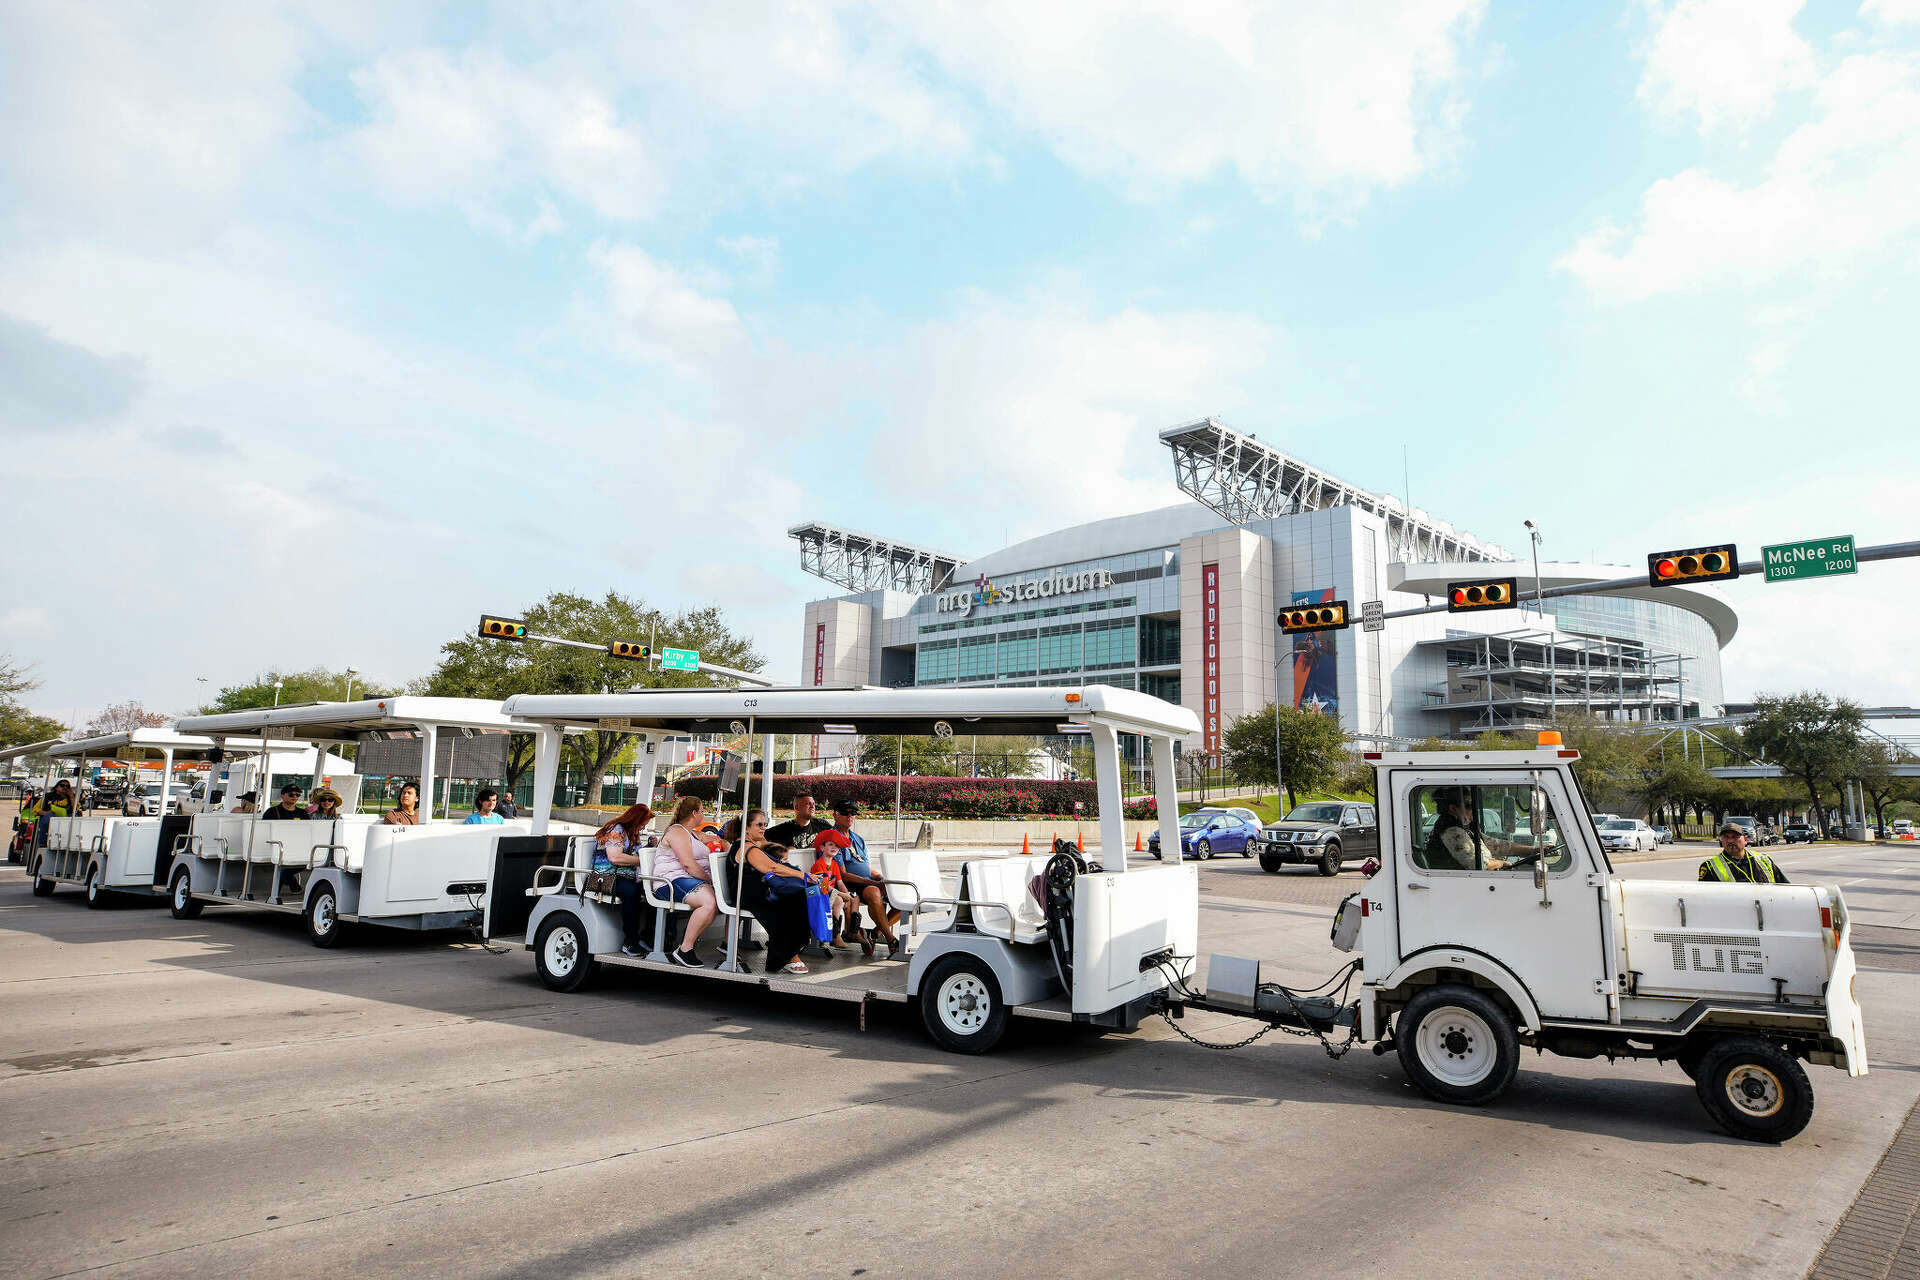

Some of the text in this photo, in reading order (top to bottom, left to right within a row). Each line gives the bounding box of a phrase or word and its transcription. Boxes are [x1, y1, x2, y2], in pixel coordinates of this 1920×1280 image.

[1768, 543, 1850, 565] McNee Rd
[1770, 559, 1852, 577] 1300 1200
[936, 567, 1107, 617] nrg stadium
[664, 650, 686, 662] Kirby
[743, 698, 758, 708] C13
[1369, 901, 1383, 912] T4
[1653, 932, 1764, 975] TUG
